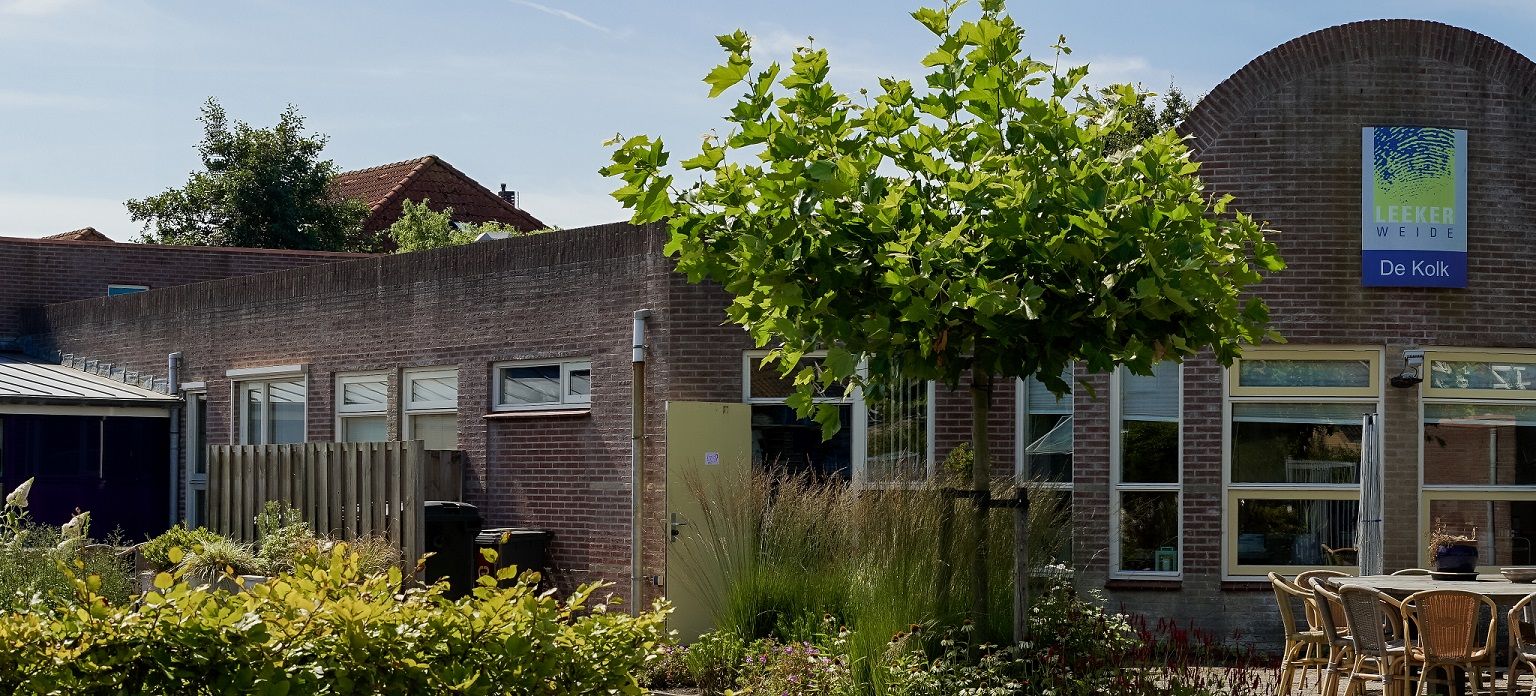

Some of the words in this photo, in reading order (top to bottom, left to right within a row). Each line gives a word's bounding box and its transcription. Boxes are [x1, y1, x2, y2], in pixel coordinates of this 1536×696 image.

[1376, 205, 1455, 225] LEEKER
[1376, 226, 1454, 239] WEIDE
[1380, 259, 1406, 276] De
[1412, 259, 1450, 277] Kolk
